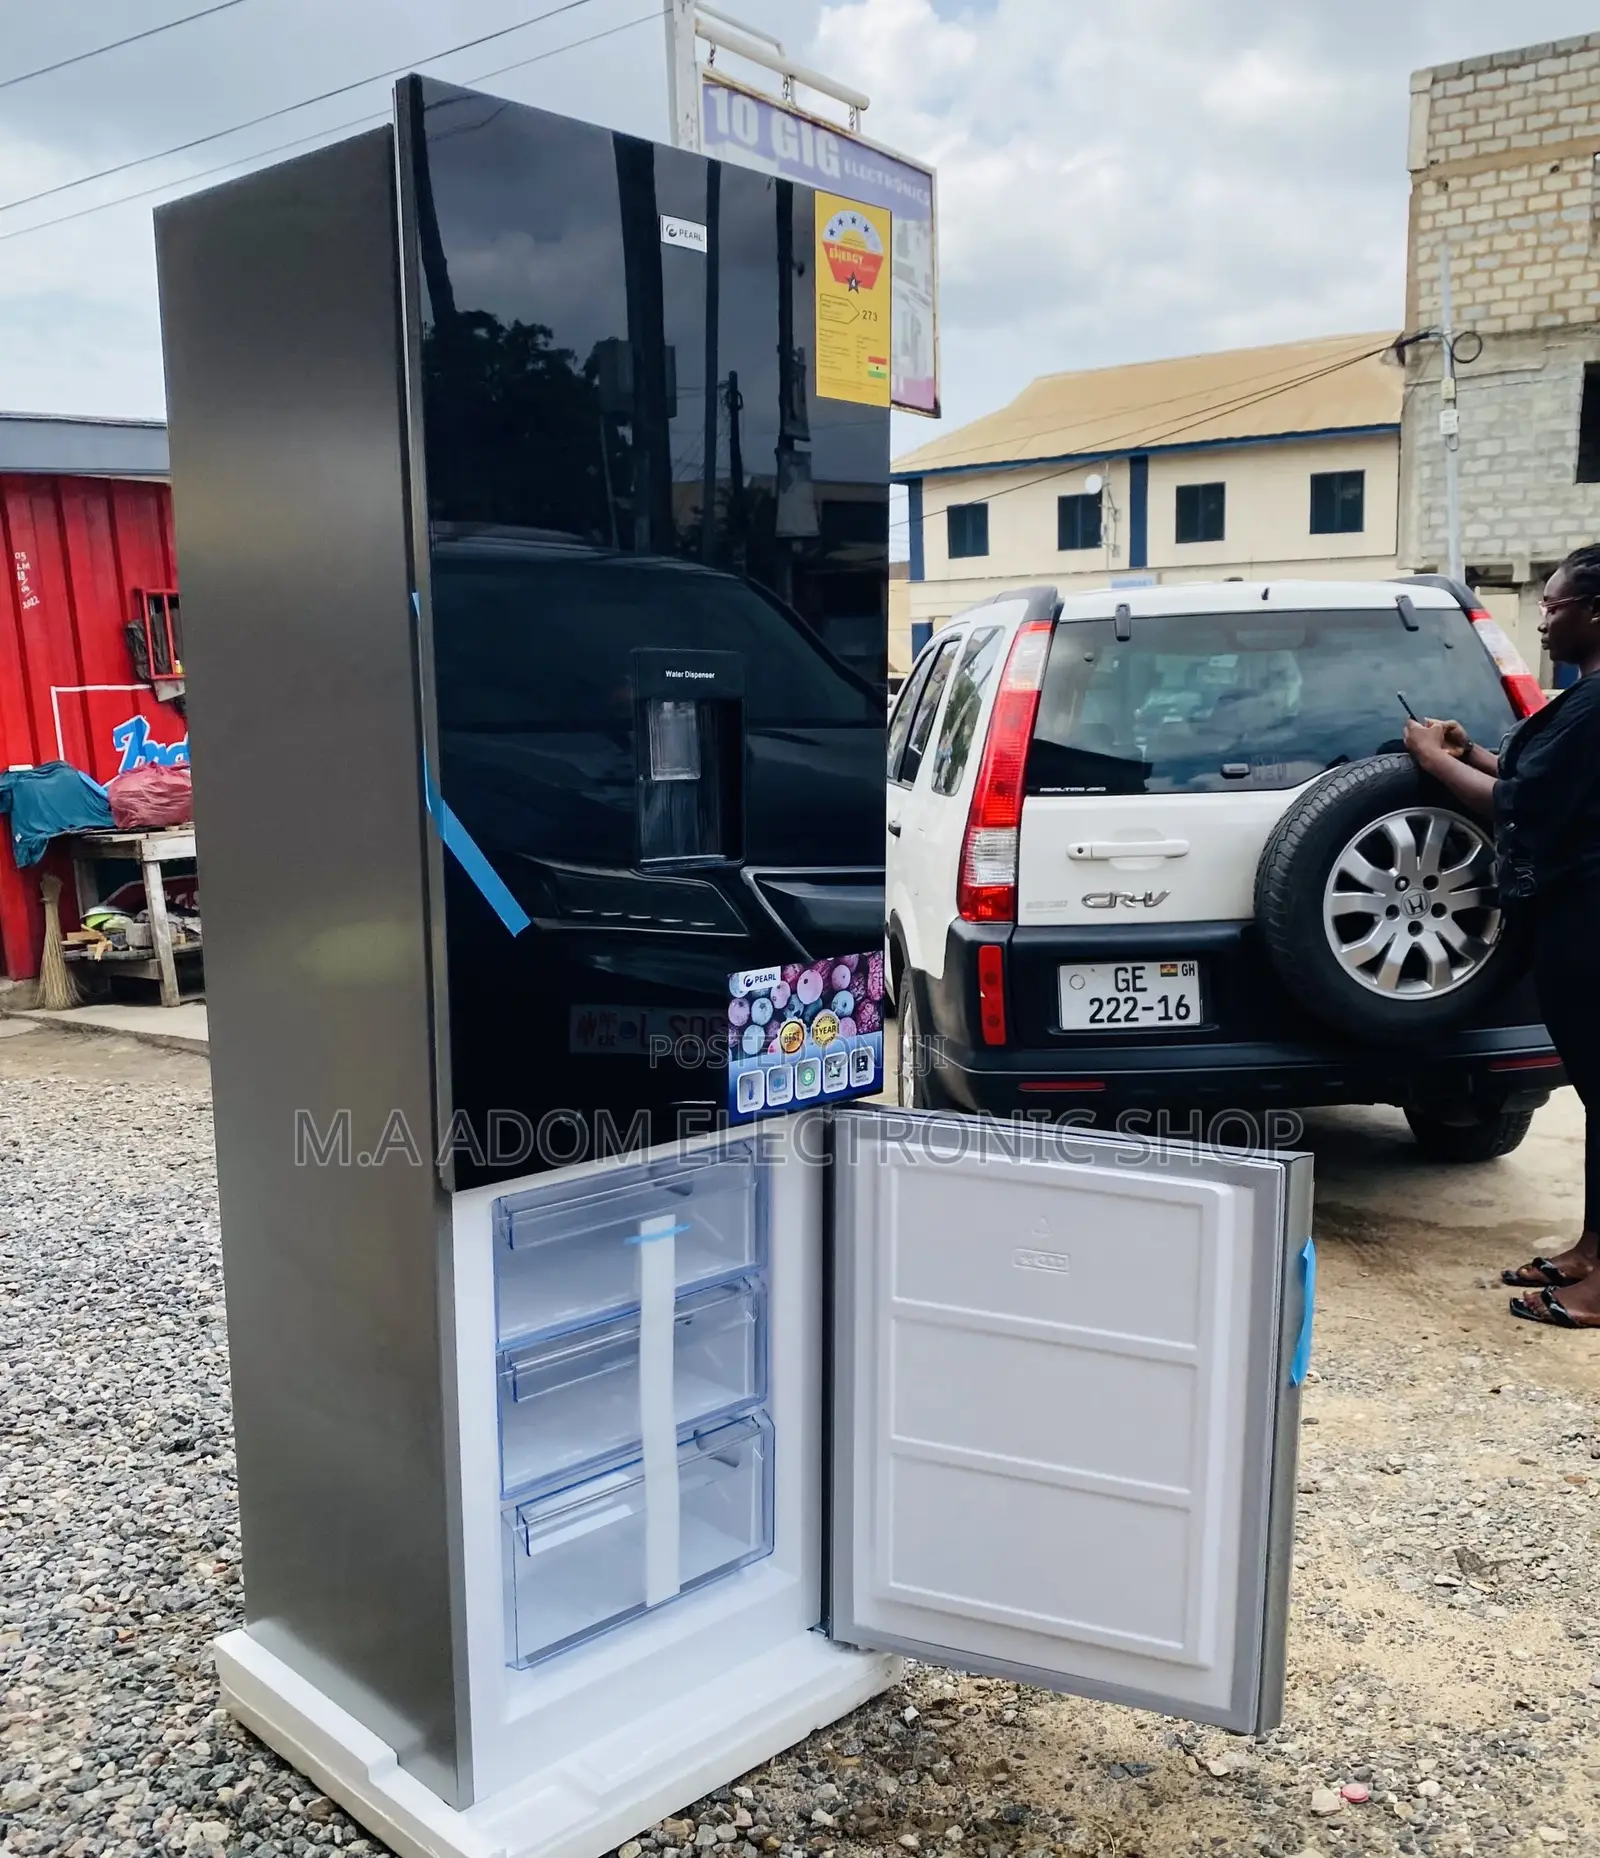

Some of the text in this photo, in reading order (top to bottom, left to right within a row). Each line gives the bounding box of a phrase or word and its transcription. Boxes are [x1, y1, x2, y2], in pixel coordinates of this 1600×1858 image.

[708, 87, 930, 206] 10 GIG ELECTRONICS
[679, 228, 702, 242] PEARL
[862, 310, 878, 322] 273
[665, 670, 715, 680] Water Dispenser
[1081, 889, 1171, 908] CR-V
[1181, 963, 1195, 977] GH
[755, 973, 777, 983] PEARL
[1114, 965, 1148, 993] GE
[1089, 994, 1191, 1024] 222-16
[818, 1025, 837, 1035] YEAR
